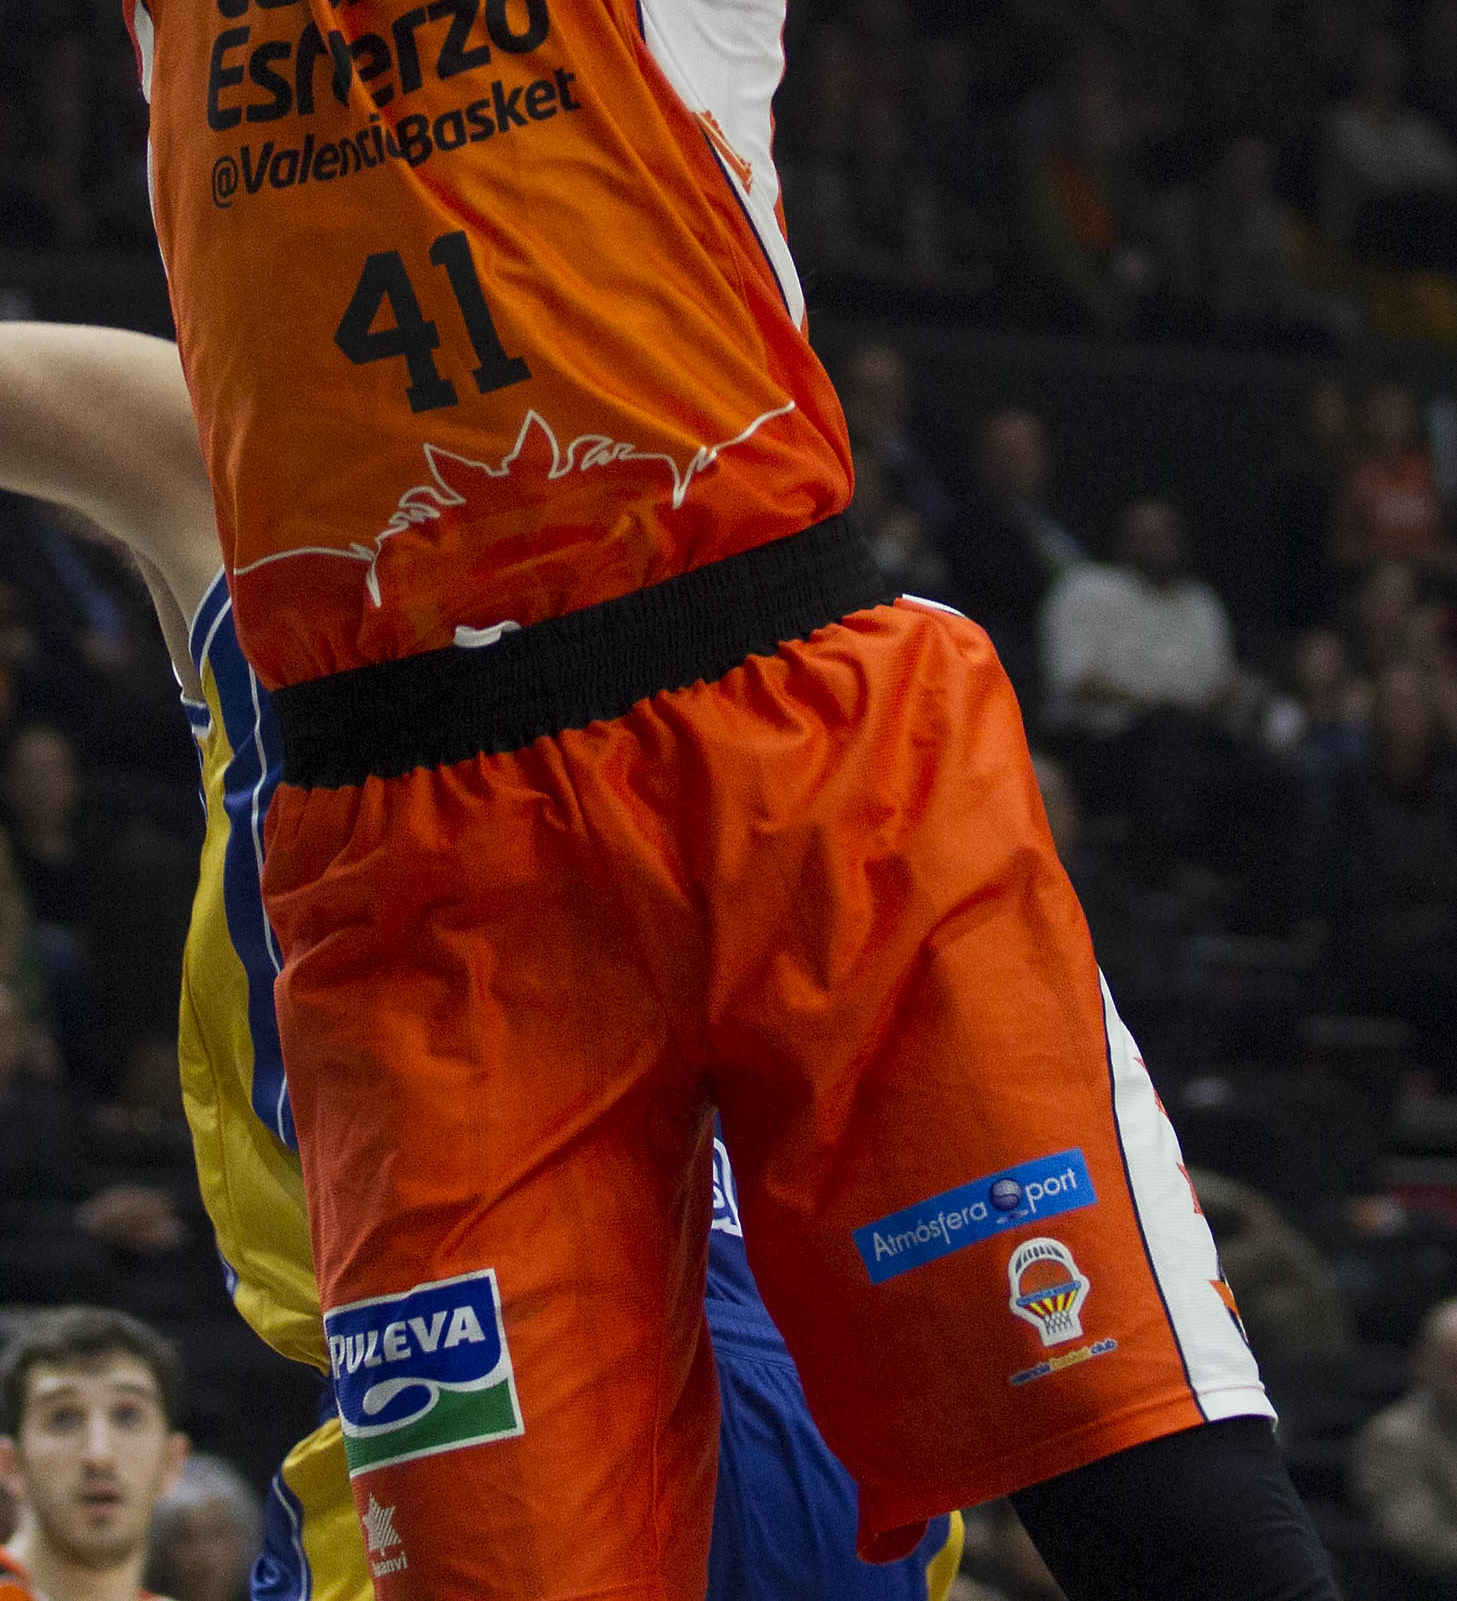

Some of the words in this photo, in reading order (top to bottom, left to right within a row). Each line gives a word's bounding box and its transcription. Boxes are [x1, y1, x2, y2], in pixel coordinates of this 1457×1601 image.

[333, 230, 533, 415] 41
[871, 1201, 989, 1253] Atmósfera
[329, 1305, 486, 1379] PULEVA
